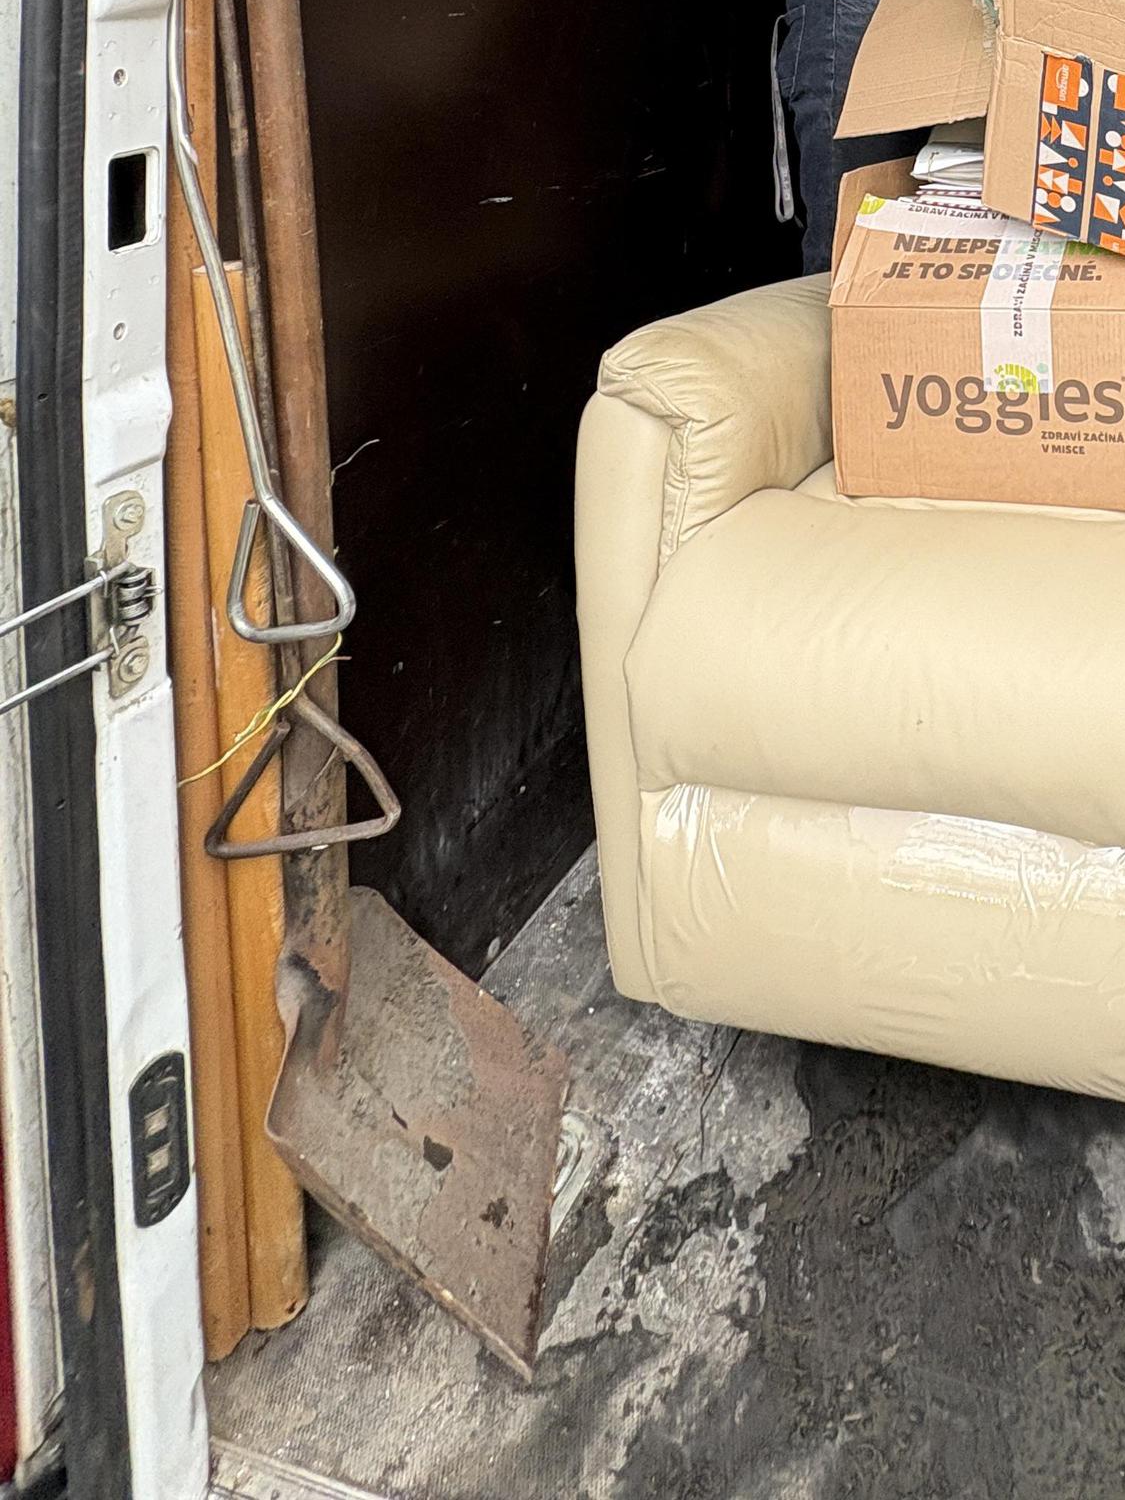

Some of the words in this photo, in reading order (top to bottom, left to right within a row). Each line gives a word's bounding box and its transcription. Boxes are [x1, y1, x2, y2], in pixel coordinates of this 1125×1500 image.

[882, 262, 913, 280] JE
[918, 263, 954, 280] TO
[1041, 430, 1081, 442] ZDRAVÍ
[1041, 444, 1050, 453] V
[1051, 444, 1086, 455] MISCE
